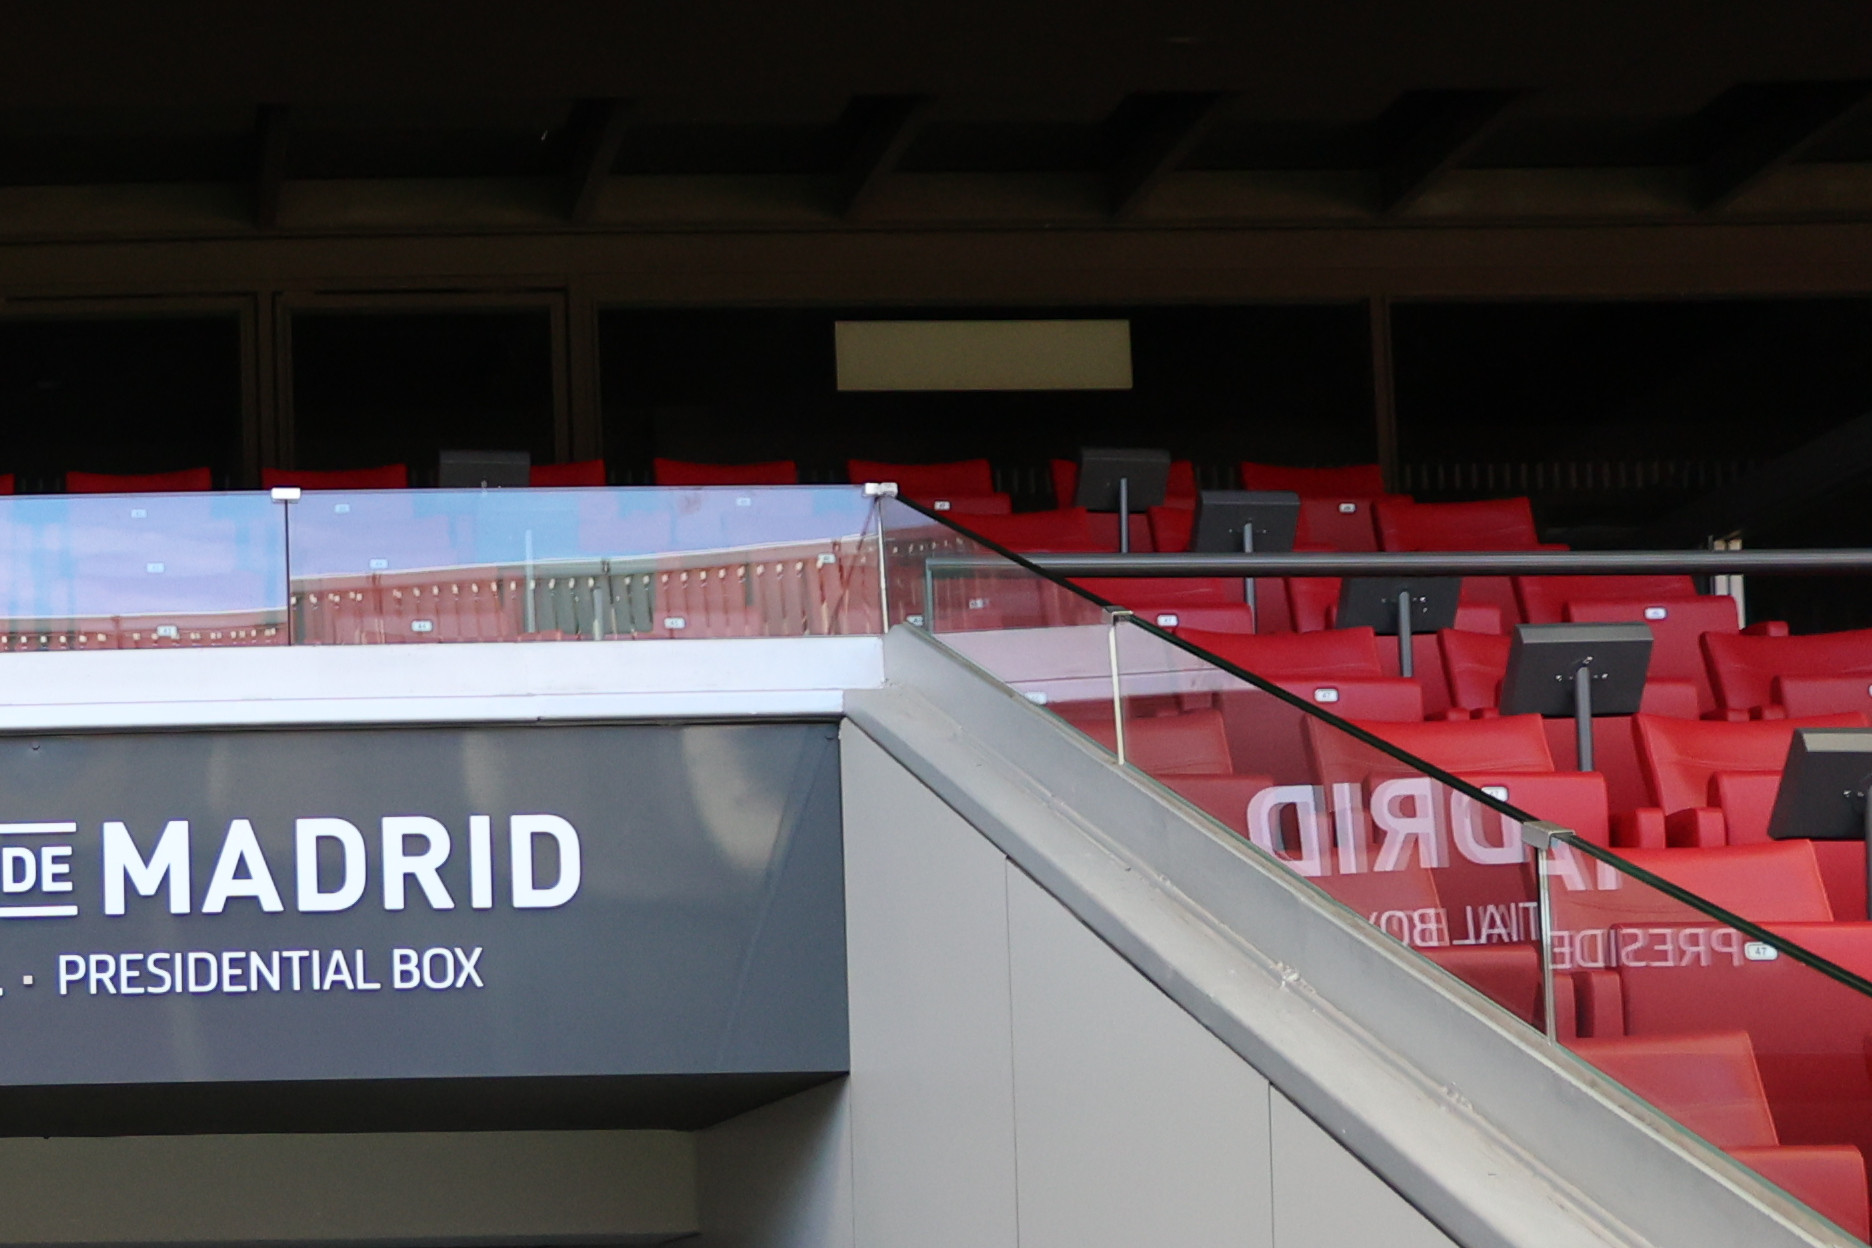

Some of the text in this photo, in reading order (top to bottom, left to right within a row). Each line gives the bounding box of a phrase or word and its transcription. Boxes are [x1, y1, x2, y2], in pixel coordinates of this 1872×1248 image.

[1, 845, 75, 894] DE
[102, 813, 582, 915] MADRID
[58, 949, 382, 996] PRESIDENTIAL
[392, 947, 485, 990] BOX
